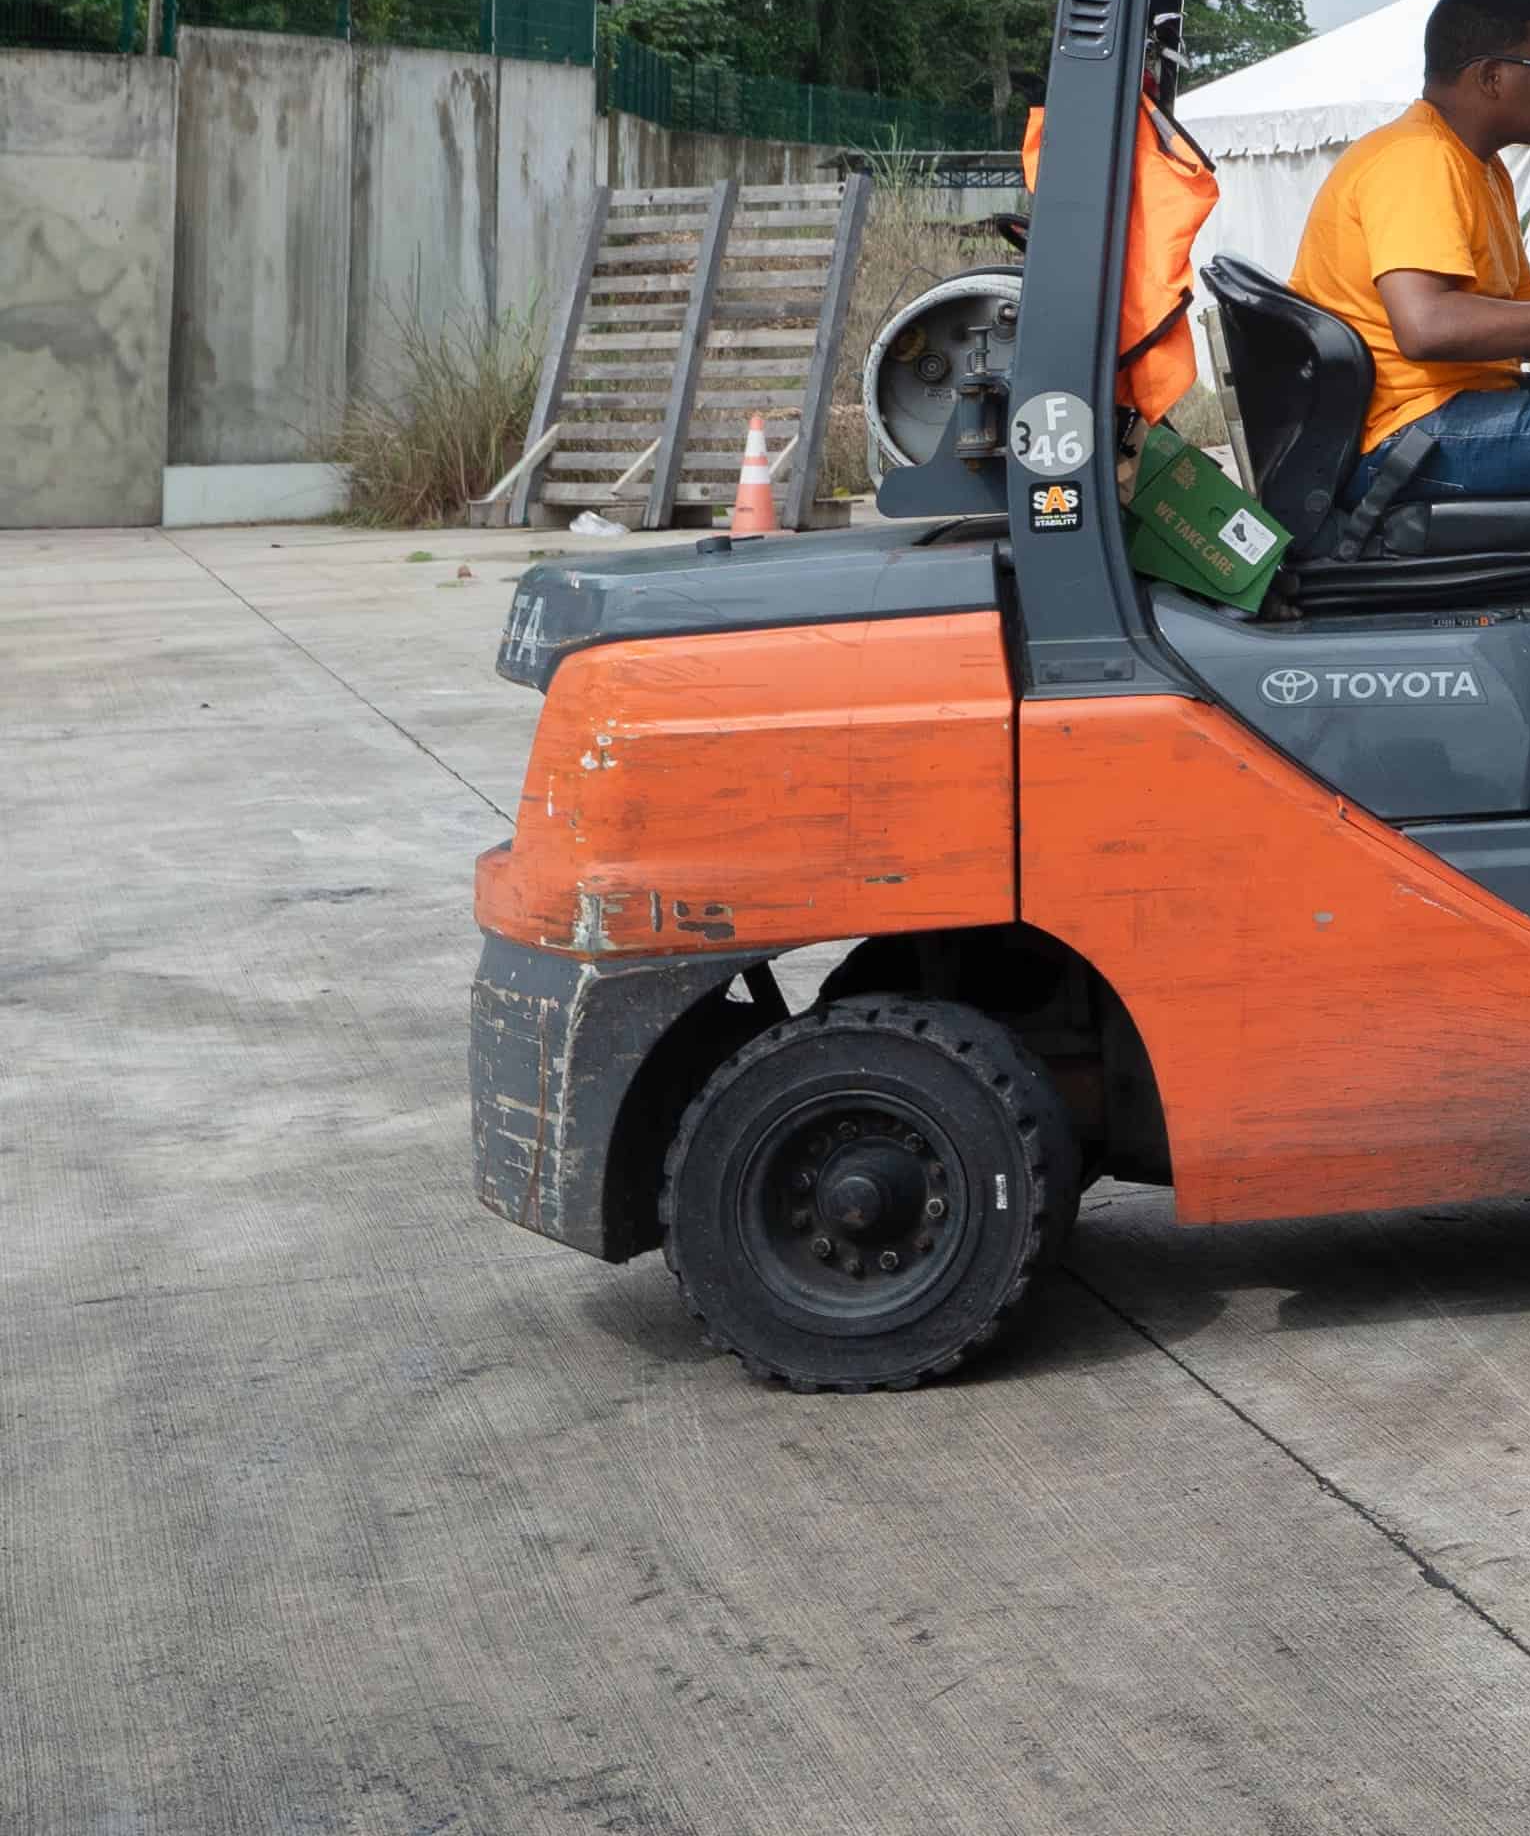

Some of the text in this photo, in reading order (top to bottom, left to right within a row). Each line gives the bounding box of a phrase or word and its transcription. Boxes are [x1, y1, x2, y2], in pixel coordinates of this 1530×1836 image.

[1045, 396, 1068, 431] F
[1033, 485, 1079, 514] SAS
[1034, 518, 1078, 527] STABILITY
[1154, 499, 1236, 577] WE TAKE CARE
[1325, 671, 1479, 699] TOYOTA
